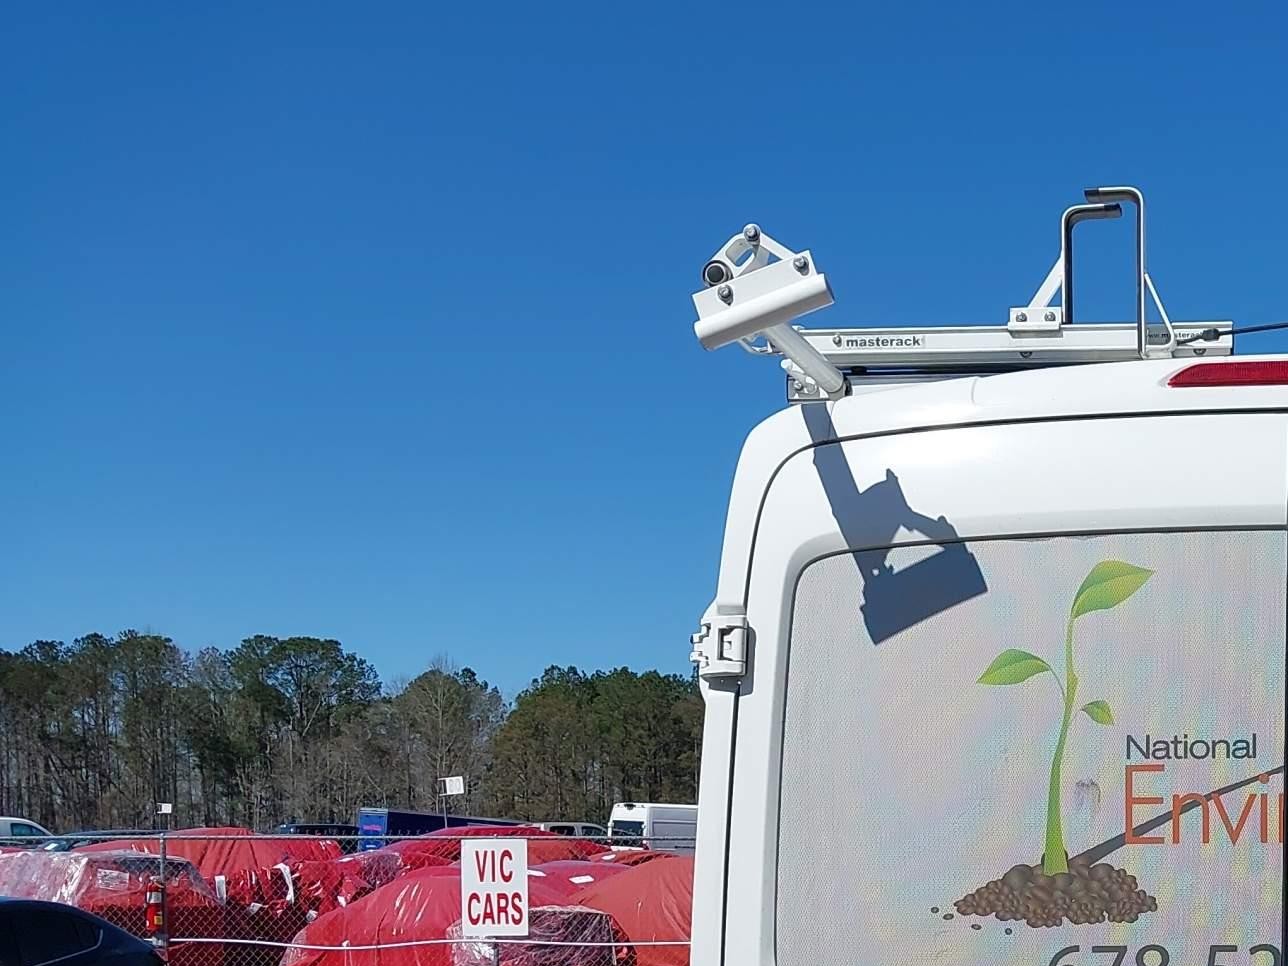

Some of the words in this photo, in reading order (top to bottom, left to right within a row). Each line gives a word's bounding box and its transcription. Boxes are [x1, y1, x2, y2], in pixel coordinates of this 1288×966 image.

[845, 335, 921, 347] masterack
[1126, 734, 1258, 761] National
[475, 849, 513, 883] VIC
[467, 892, 524, 926] CARS
